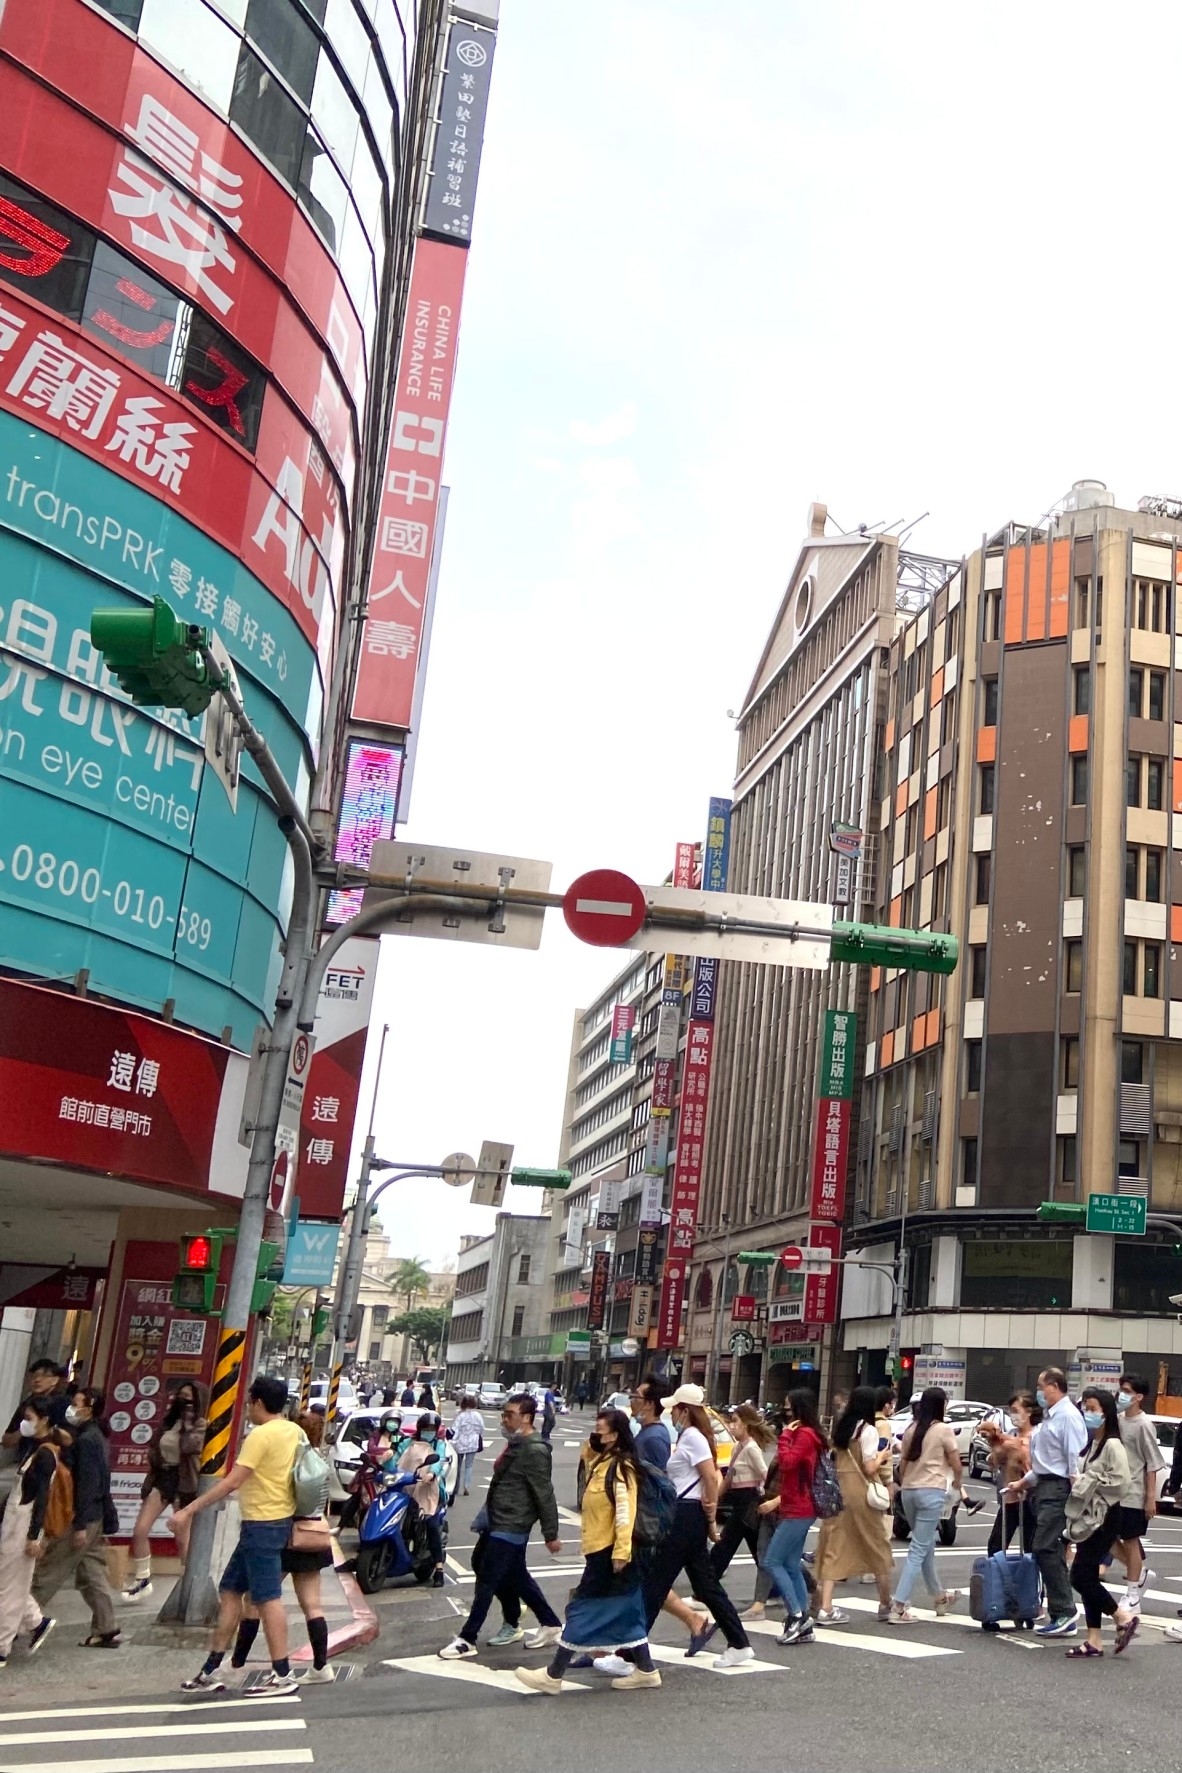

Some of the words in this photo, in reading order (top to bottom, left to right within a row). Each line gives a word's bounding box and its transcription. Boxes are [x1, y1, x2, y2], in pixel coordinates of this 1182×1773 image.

[405, 299, 432, 398] INSURANCE
[432, 304, 453, 371] CHINA
[426, 375, 444, 403] LIFE
[8, 465, 161, 584] transPRK
[365, 469, 437, 661] 中國人壽
[168, 557, 288, 683] 零接觸好安心
[41, 743, 104, 791] eye
[11, 843, 212, 951] 0800-010-589
[326, 973, 365, 989] FET
[664, 990, 680, 1001] 8F
[106, 1049, 161, 1098] 遠傳
[689, 1026, 710, 1066] 高點
[830, 1014, 848, 1079] 智勝出版
[59, 1095, 153, 1138] 館前直營門市
[305, 1094, 341, 1166] 遠傳
[820, 1101, 842, 1200] 貝塔語言出版
[1092, 1197, 1138, 1209] 漢口街一段
